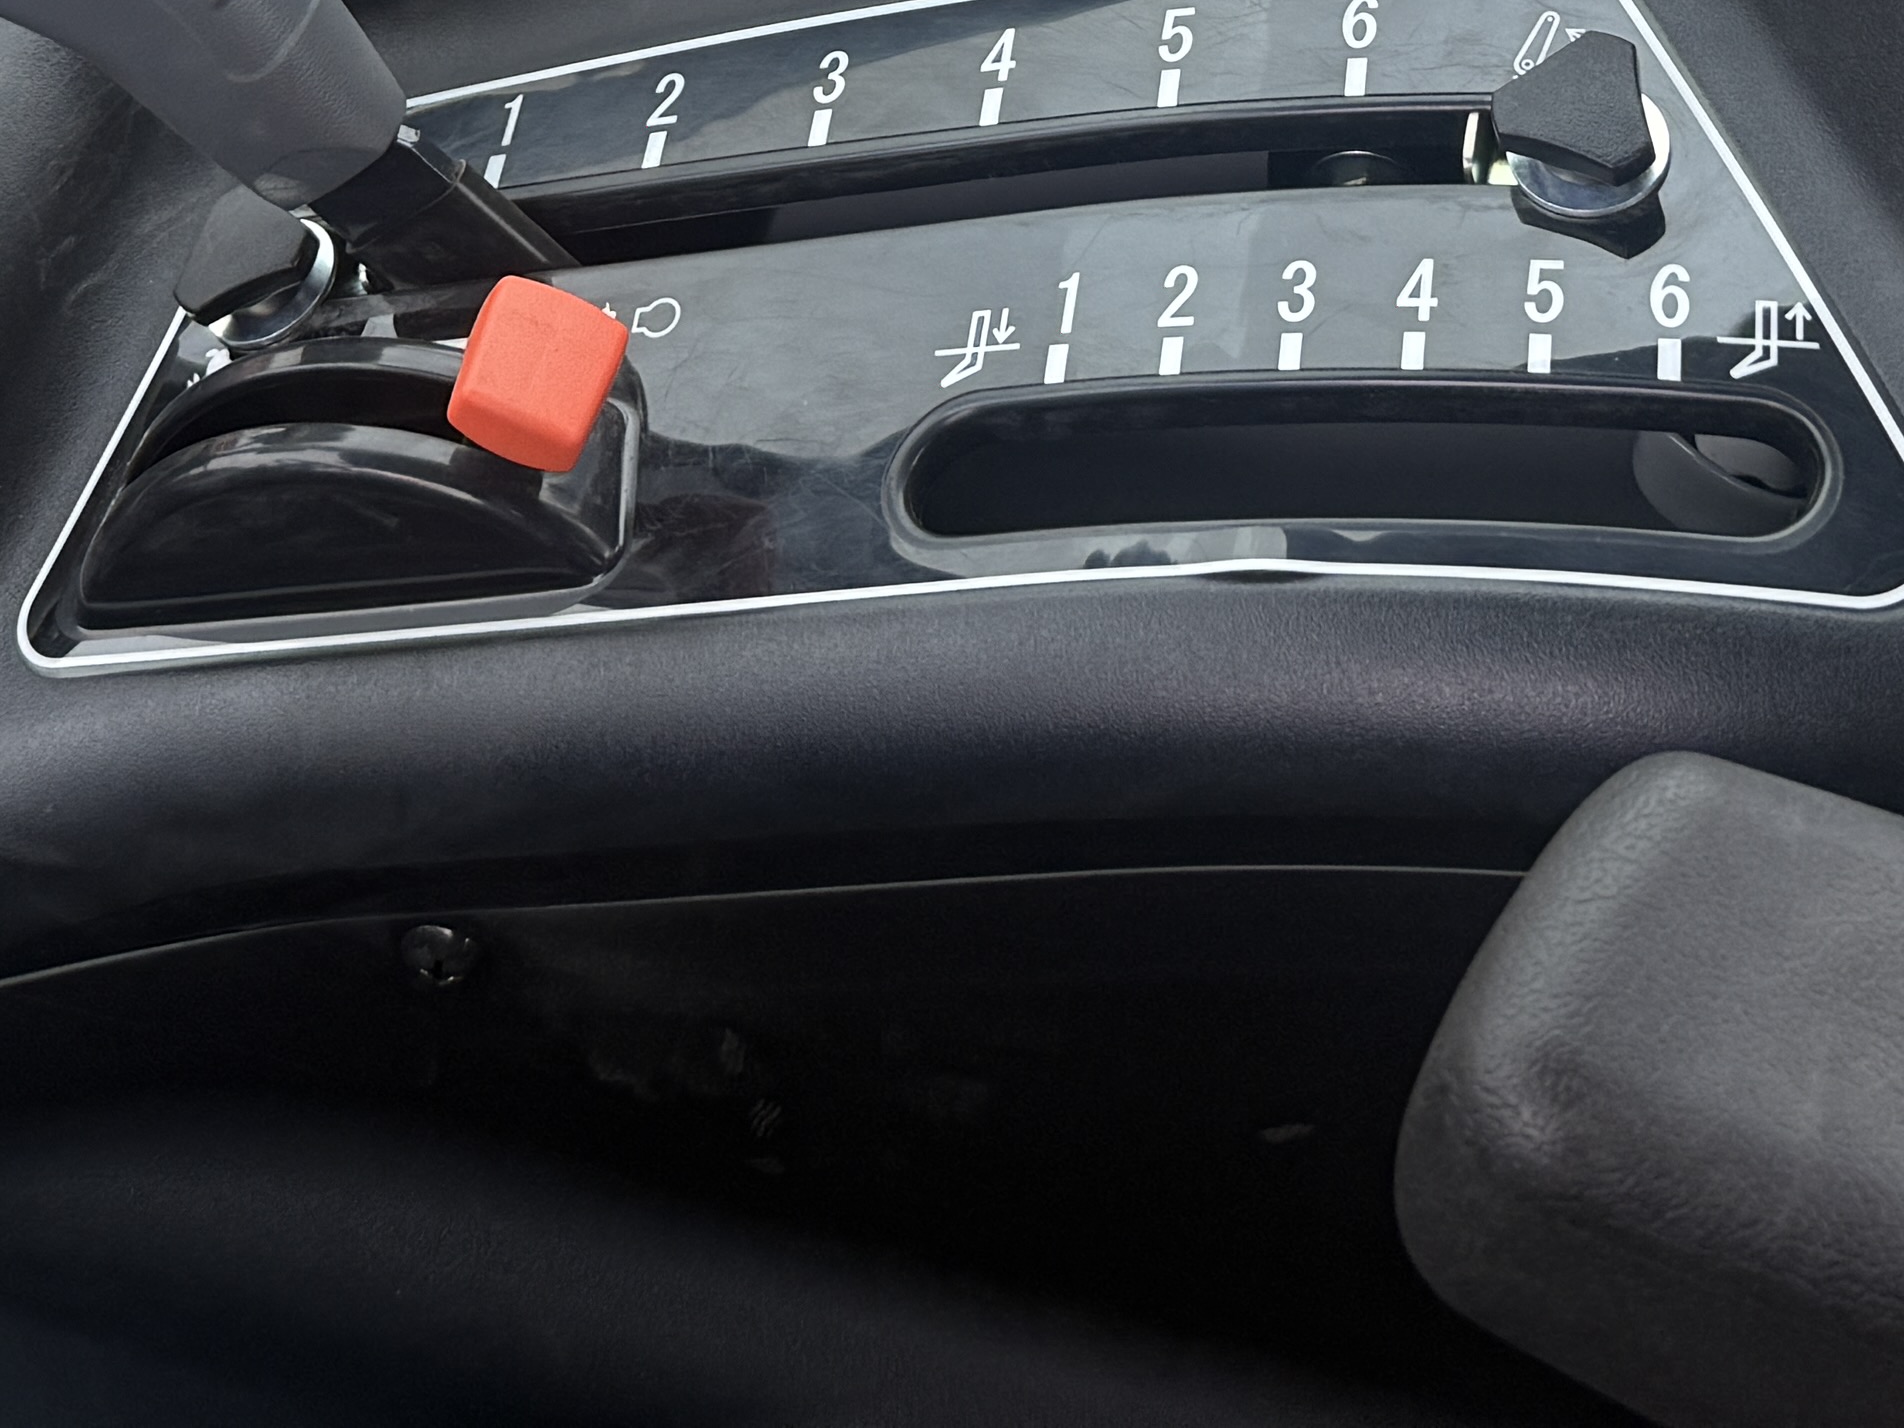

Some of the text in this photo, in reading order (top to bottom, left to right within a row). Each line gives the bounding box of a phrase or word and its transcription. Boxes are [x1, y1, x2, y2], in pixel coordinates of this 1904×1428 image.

[501, 94, 526, 147] 1
[647, 73, 687, 126] 2
[812, 51, 850, 106] 3
[977, 27, 1018, 82] 4
[1158, 7, 1197, 64] 5
[1055, 258, 1690, 332] 1 2 3 4 5 6
